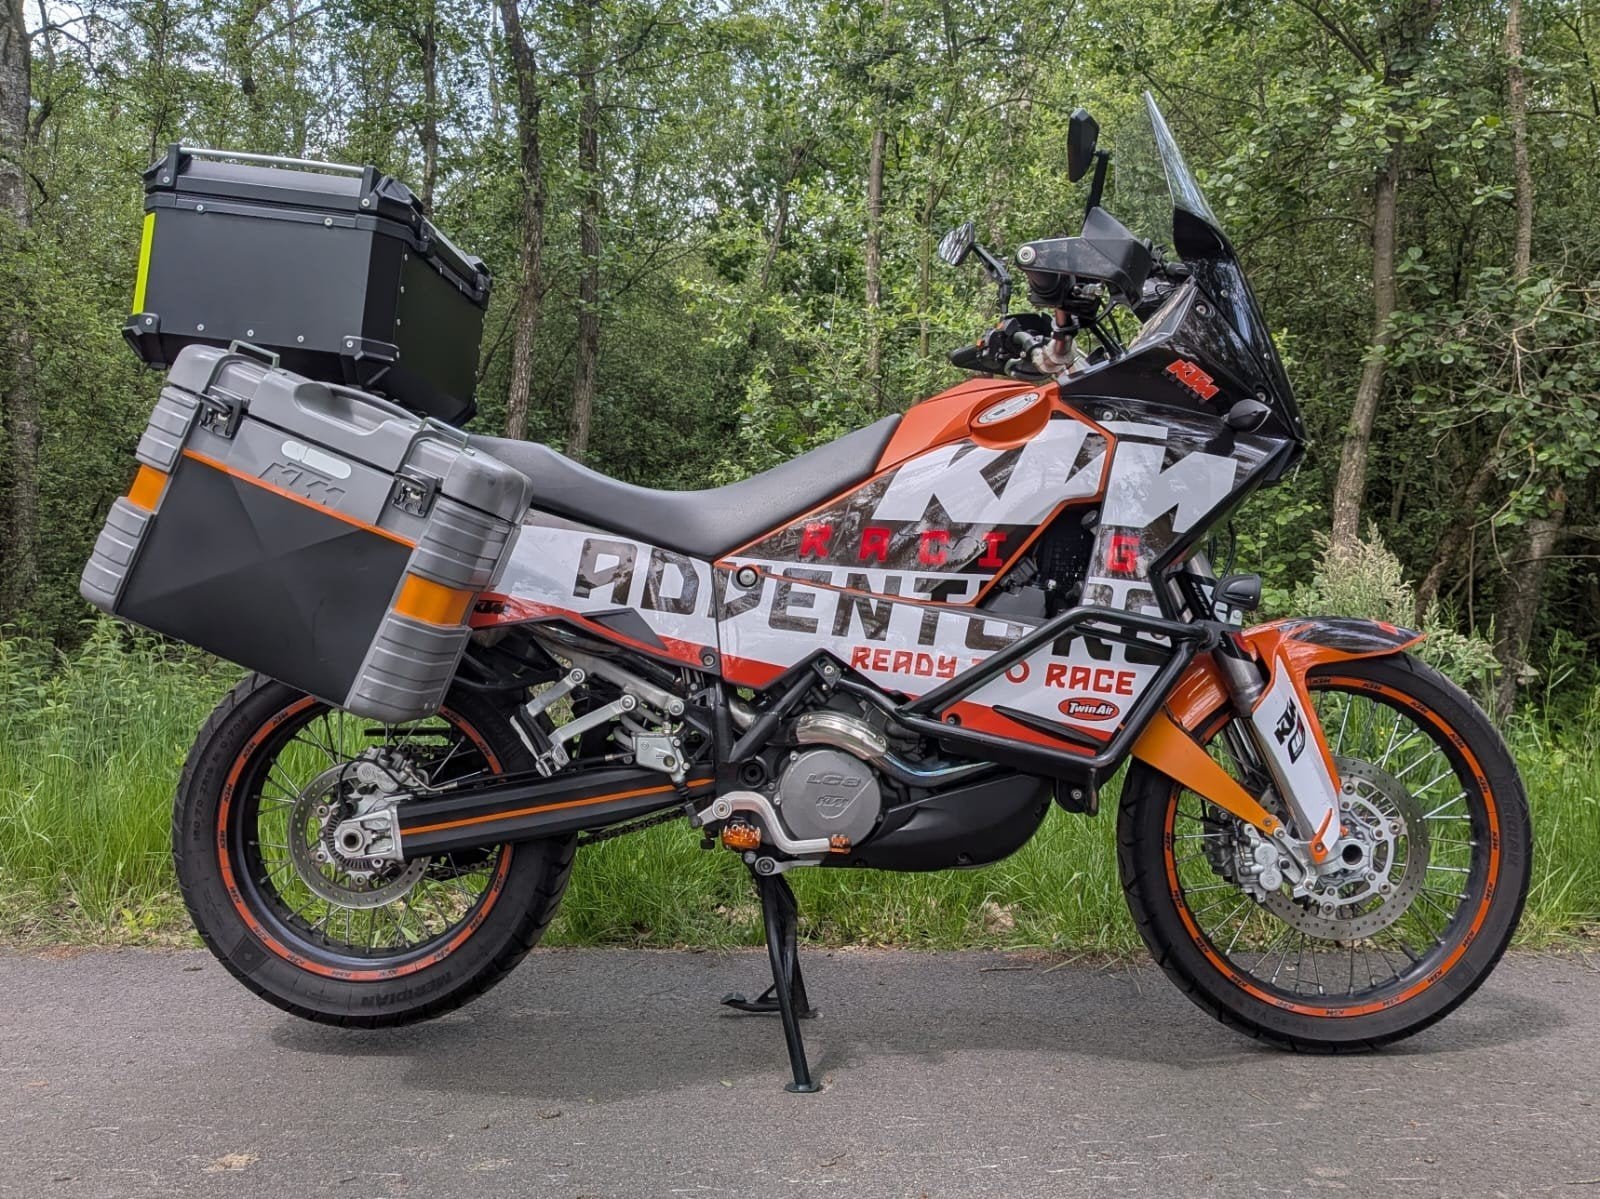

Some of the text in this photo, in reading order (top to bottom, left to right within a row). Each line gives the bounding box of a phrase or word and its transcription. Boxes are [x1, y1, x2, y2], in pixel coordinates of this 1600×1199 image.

[1166, 359, 1220, 401] KTM
[871, 419, 1238, 534] KTM
[800, 522, 1141, 573] RACIG
[851, 646, 1137, 696] READY O RACE
[1273, 695, 1297, 747] KTM
[806, 773, 862, 788] LC8
